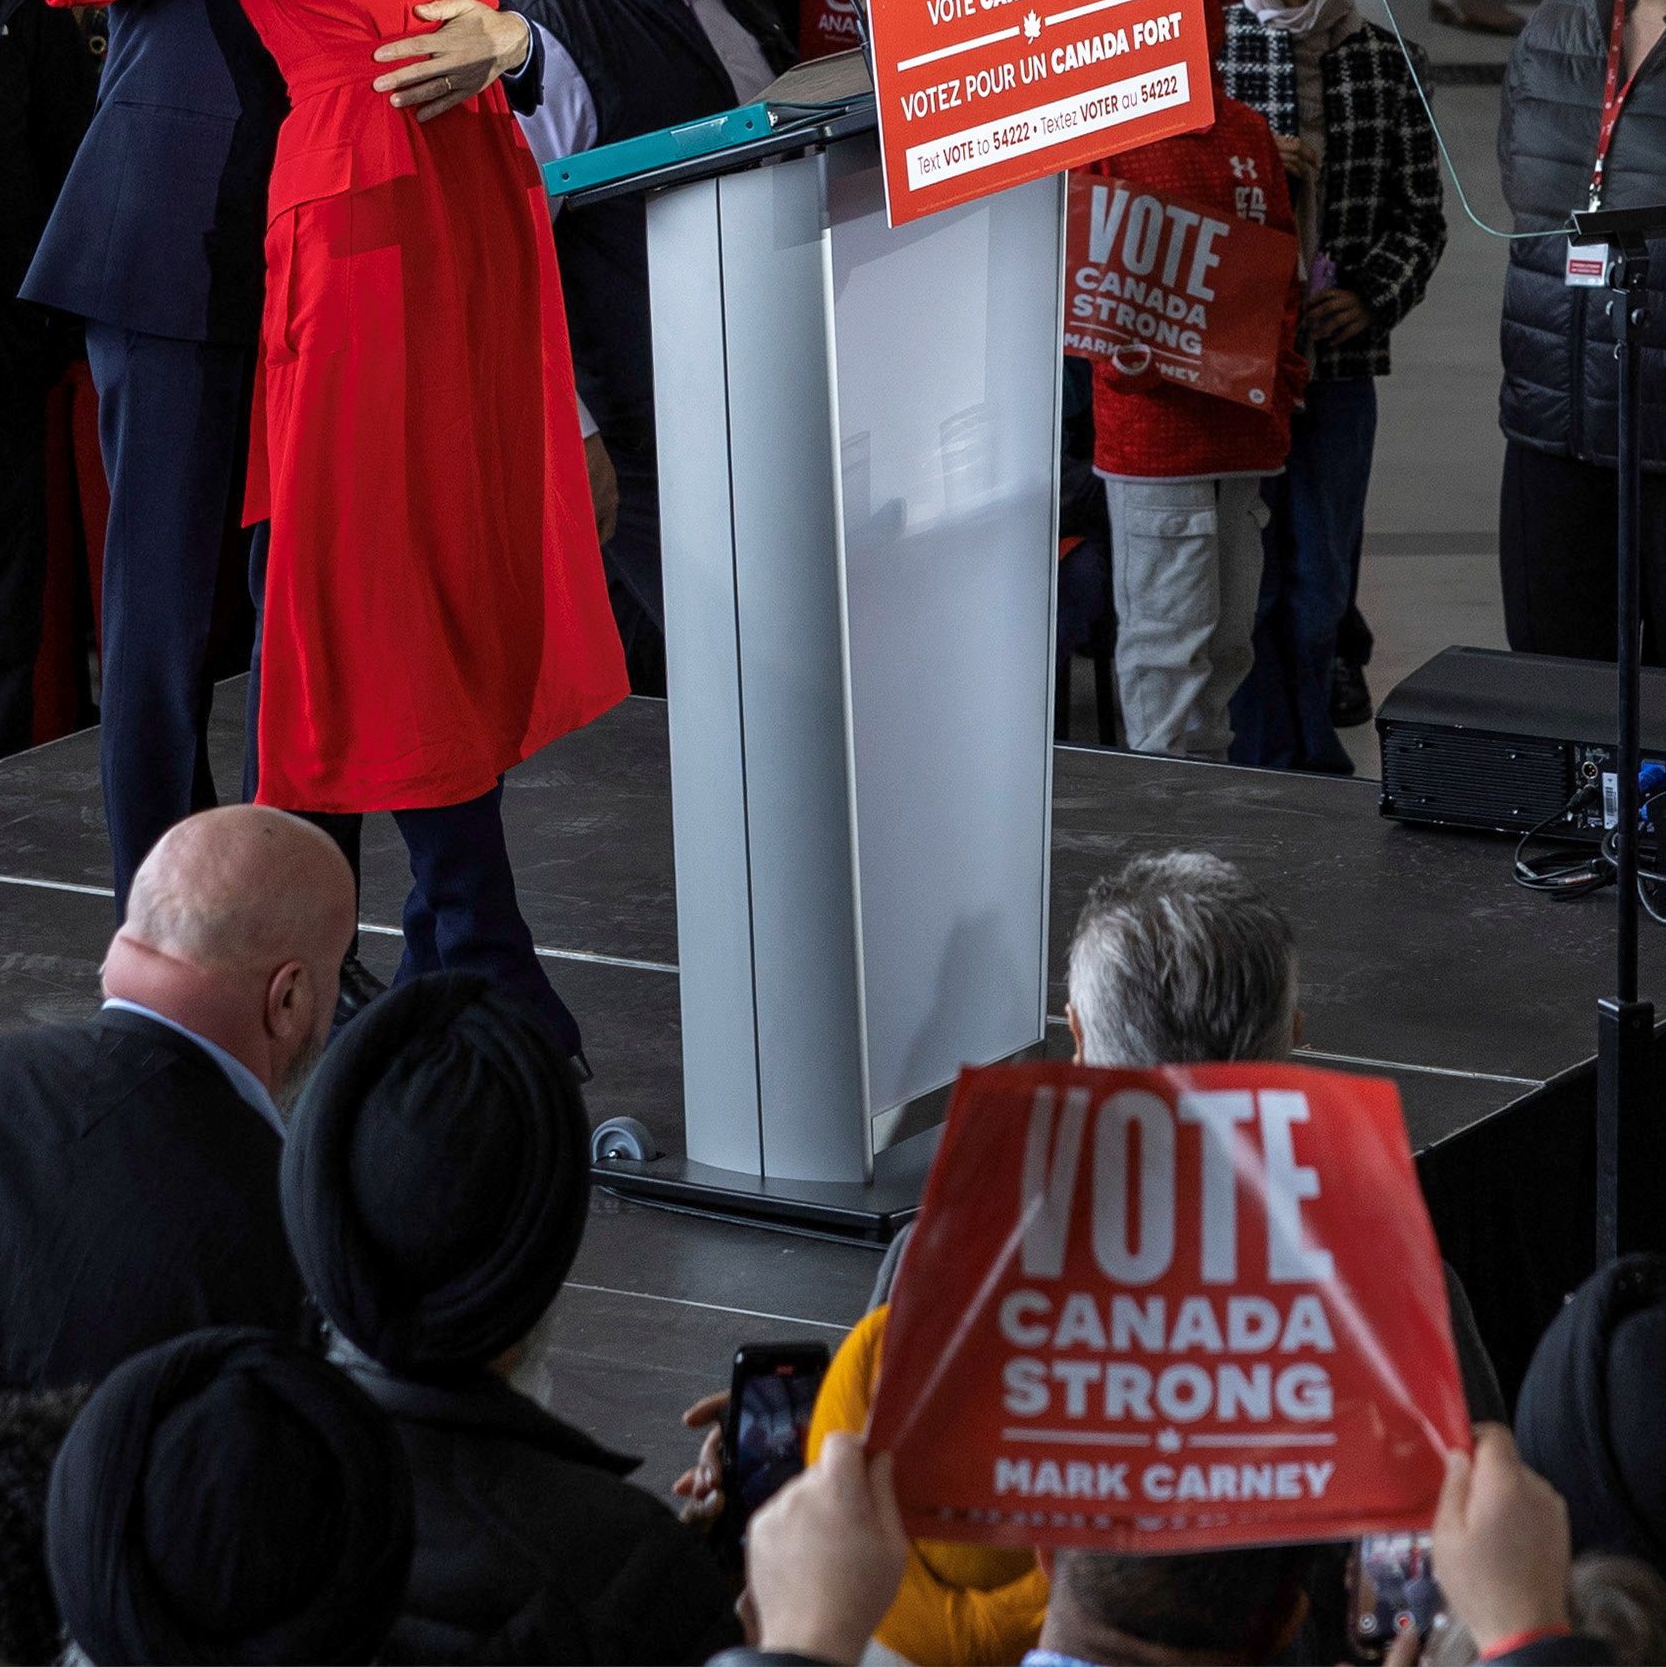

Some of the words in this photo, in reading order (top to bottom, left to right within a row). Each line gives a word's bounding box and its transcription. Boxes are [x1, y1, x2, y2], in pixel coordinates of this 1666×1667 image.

[900, 81, 962, 122] VOTEZ
[965, 63, 1016, 103] POUR
[1019, 52, 1048, 84] UN
[1051, 27, 1131, 75] CANADA
[1133, 11, 1182, 47] FORT
[917, 154, 942, 175] Text
[942, 140, 975, 166] VOTE
[977, 138, 991, 156] to
[992, 121, 1031, 151] 54222
[1040, 110, 1079, 135] Textez
[1079, 95, 1120, 124] VOTER
[1121, 90, 1139, 110] au
[1140, 75, 1179, 103] 54222
[1090, 184, 1231, 303] VOTE
[1072, 293, 1204, 355] STRONG
[1074, 266, 1209, 327] CANADA
[1020, 1086, 1335, 1286] VOTE
[999, 1289, 1337, 1354] CANADA
[1001, 1359, 1335, 1422] STRONG
[994, 1456, 1130, 1501] MARK
[1141, 1459, 1335, 1503] CARNEY
